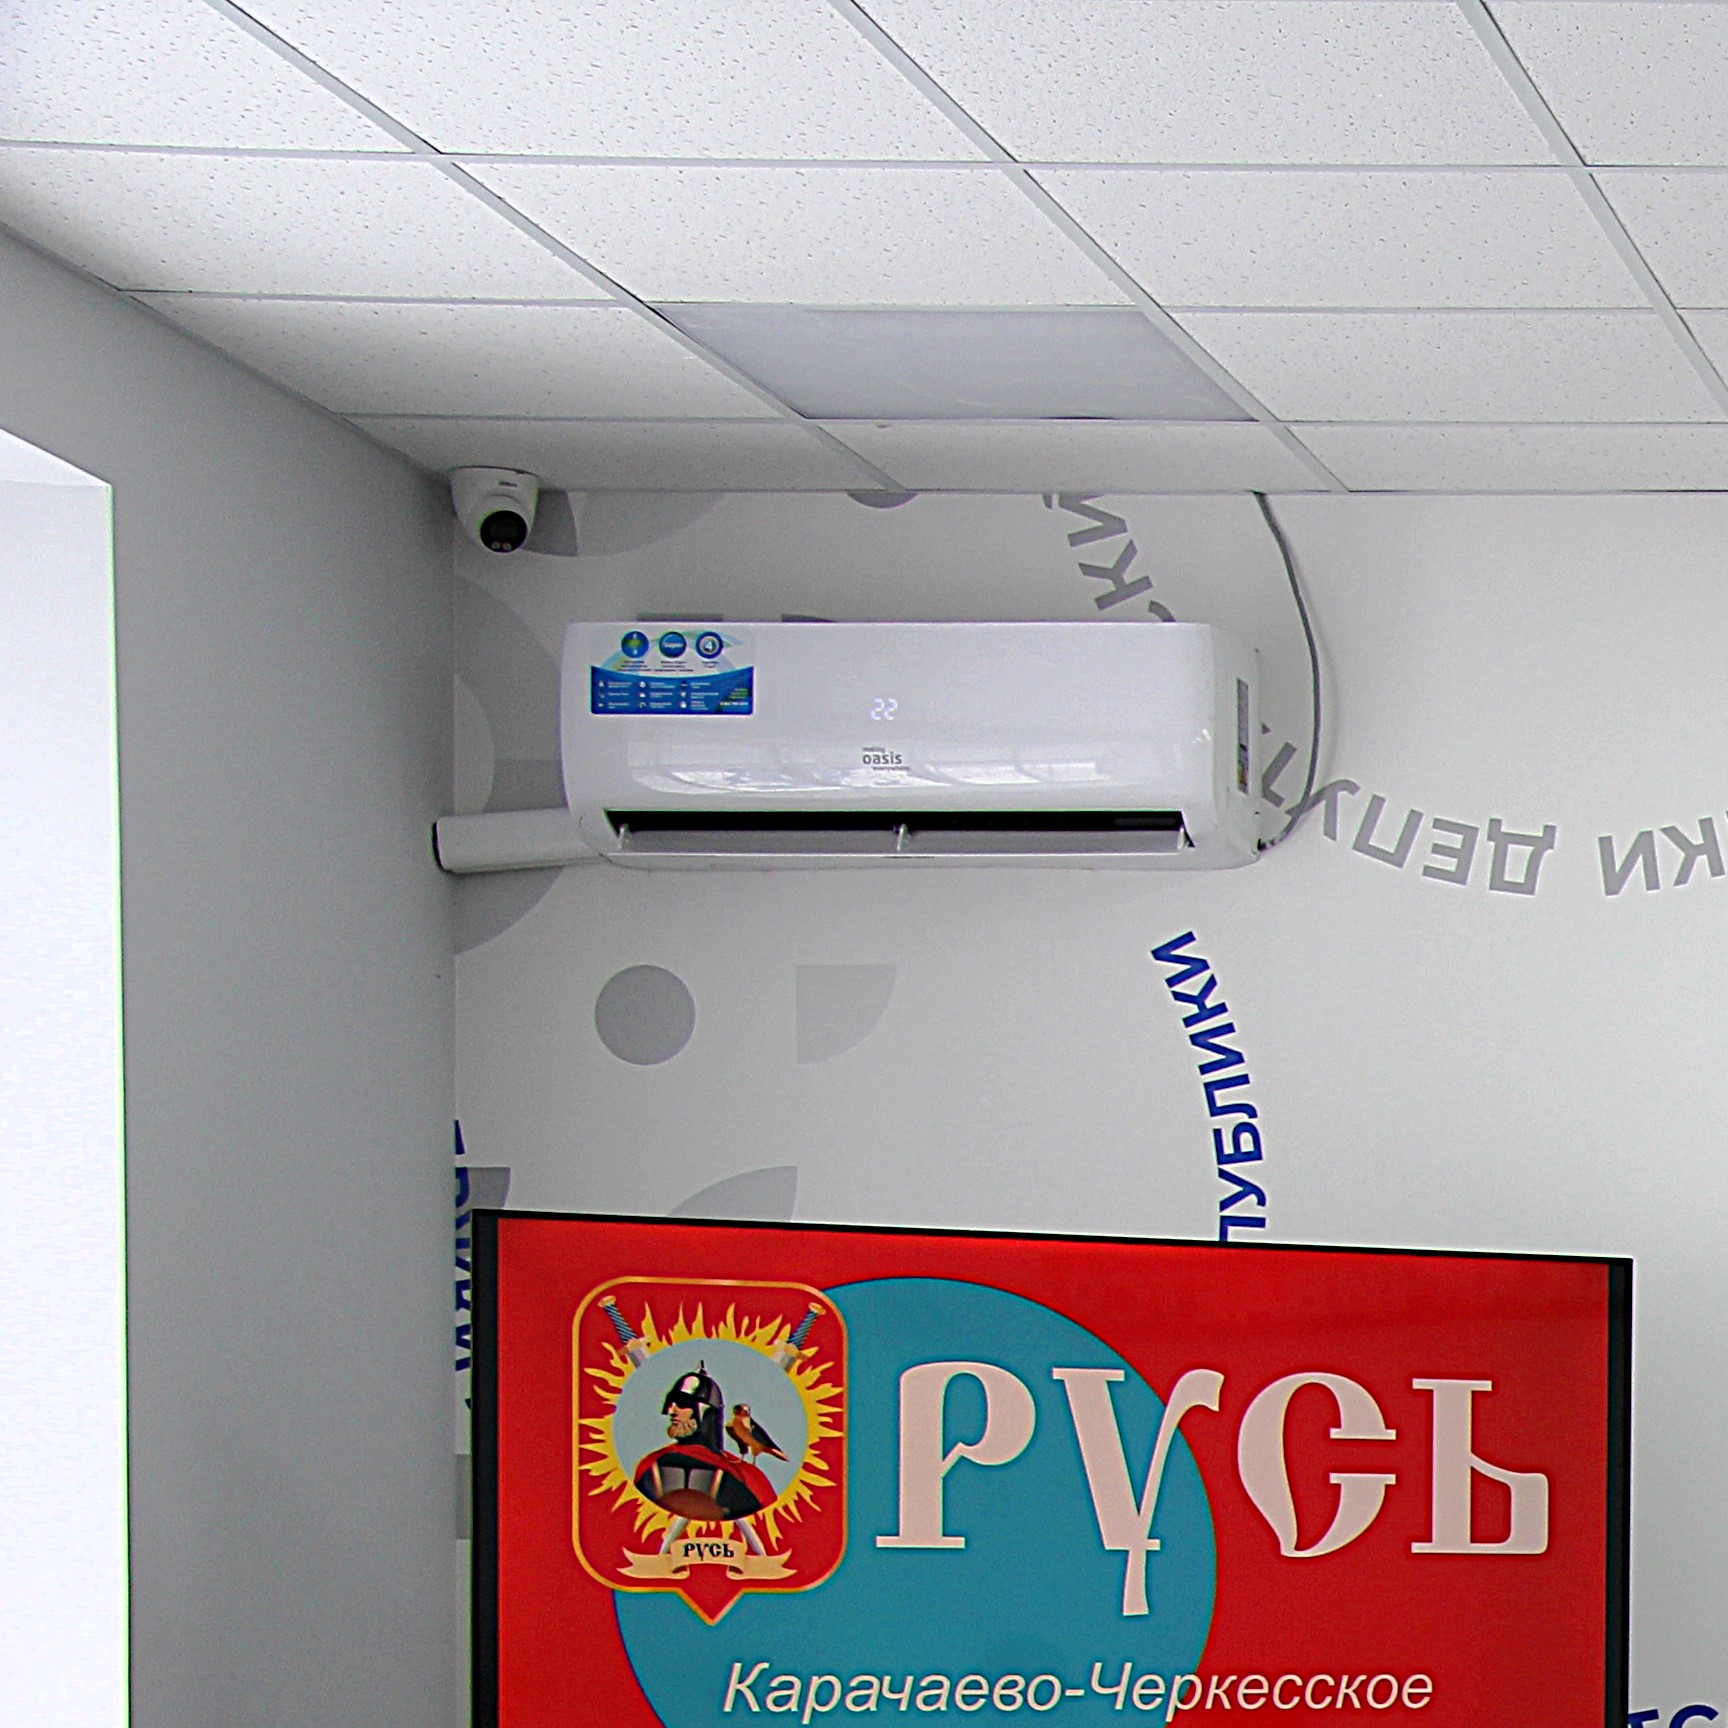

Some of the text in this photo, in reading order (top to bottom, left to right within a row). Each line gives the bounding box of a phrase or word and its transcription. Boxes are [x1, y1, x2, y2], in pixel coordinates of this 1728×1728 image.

[870, 698, 898, 721] 22
[862, 751, 903, 765] oasis
[876, 1361, 1549, 1617] РУСЬ
[723, 1662, 1434, 1725] Карачаево-Черкесское
